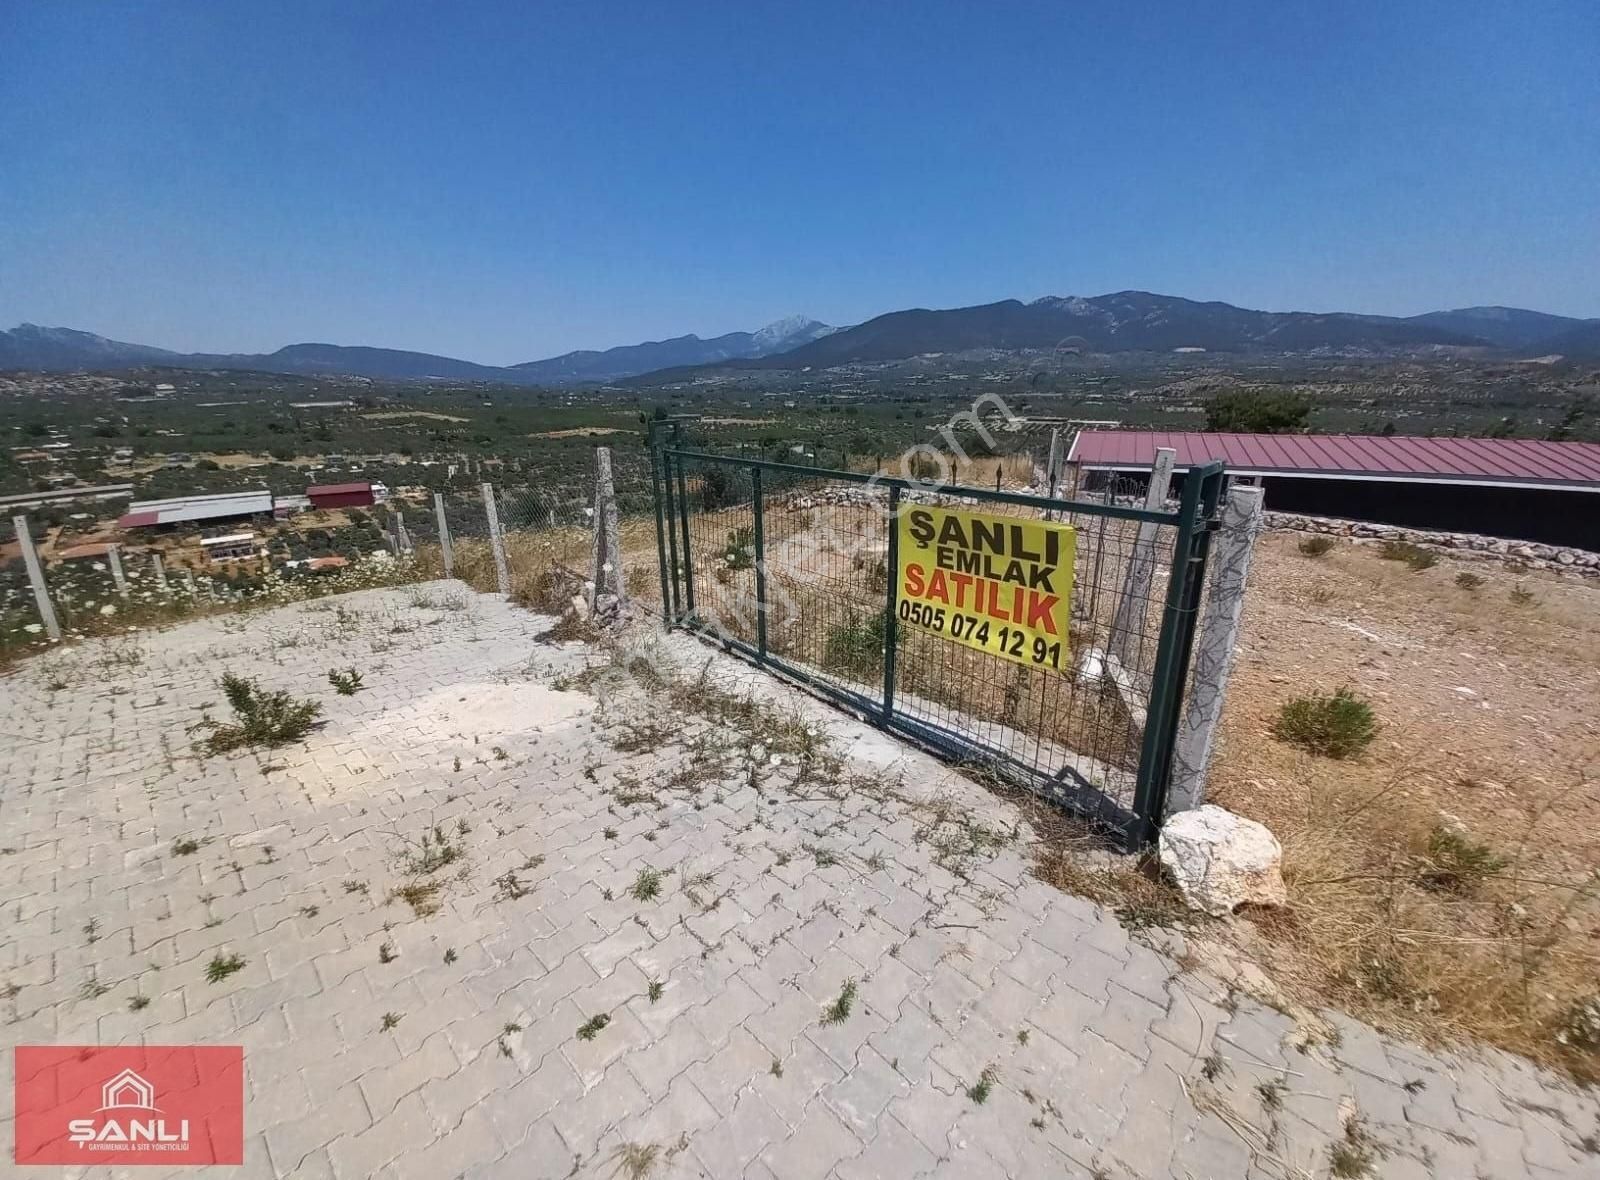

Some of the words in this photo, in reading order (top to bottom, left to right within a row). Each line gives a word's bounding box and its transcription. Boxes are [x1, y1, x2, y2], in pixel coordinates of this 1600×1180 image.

[909, 510, 1059, 566] ŞANLI
[904, 563, 1060, 635] SATILIK
[936, 546, 1056, 594] EMLAK
[900, 599, 946, 632] 0505
[951, 613, 990, 646] 074
[998, 627, 1025, 658] 12
[1031, 637, 1061, 668] 91
